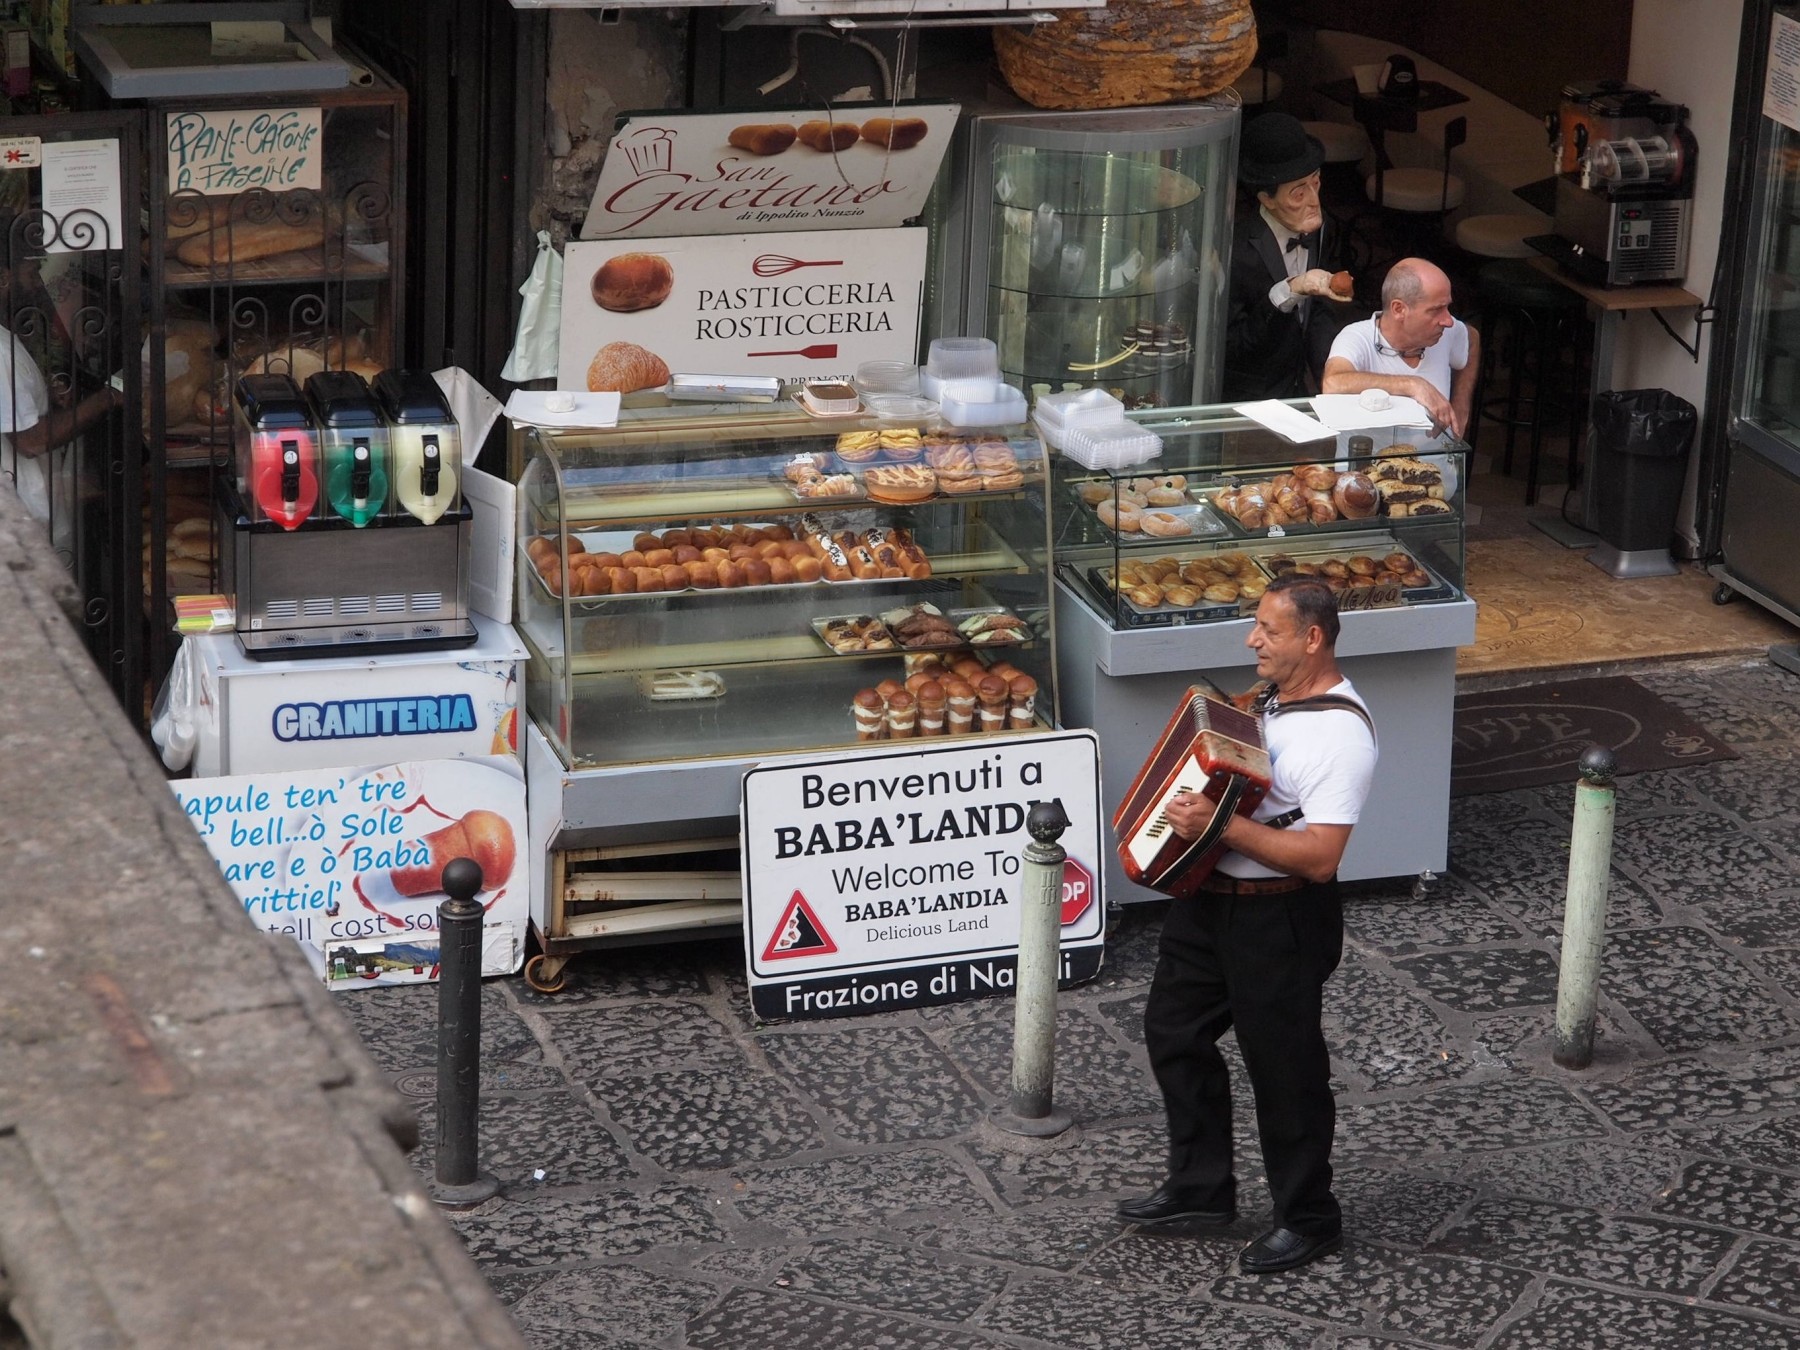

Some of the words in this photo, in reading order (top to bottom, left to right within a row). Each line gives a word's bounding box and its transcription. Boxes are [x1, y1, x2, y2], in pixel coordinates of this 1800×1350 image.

[695, 157, 780, 184] San
[594, 173, 907, 235] Gaetano
[736, 208, 754, 221] di
[754, 205, 810, 222] Ippolito
[812, 207, 866, 220] Nunzio
[697, 282, 896, 311] PASTICCERIA
[695, 311, 894, 340] ROSTICCERIA
[274, 695, 475, 740] GRANITERIA
[359, 779, 406, 802] tre
[802, 754, 1002, 809] Benvenuti
[1020, 762, 1042, 785] a
[340, 808, 404, 840] Sole
[217, 857, 276, 882] are
[290, 857, 305, 877] e
[320, 847, 337, 874] ò
[352, 840, 430, 872] Babà
[832, 860, 975, 894] Welcome
[984, 850, 1020, 877] To
[844, 887, 1008, 923] BABA'LANDIA
[1061, 882, 1086, 903] OP
[330, 914, 387, 938] cost
[866, 924, 943, 943] Delicious
[948, 916, 989, 933] Land
[785, 978, 918, 1013] Frazione
[929, 966, 956, 995] di
[969, 953, 1071, 990] Nali
